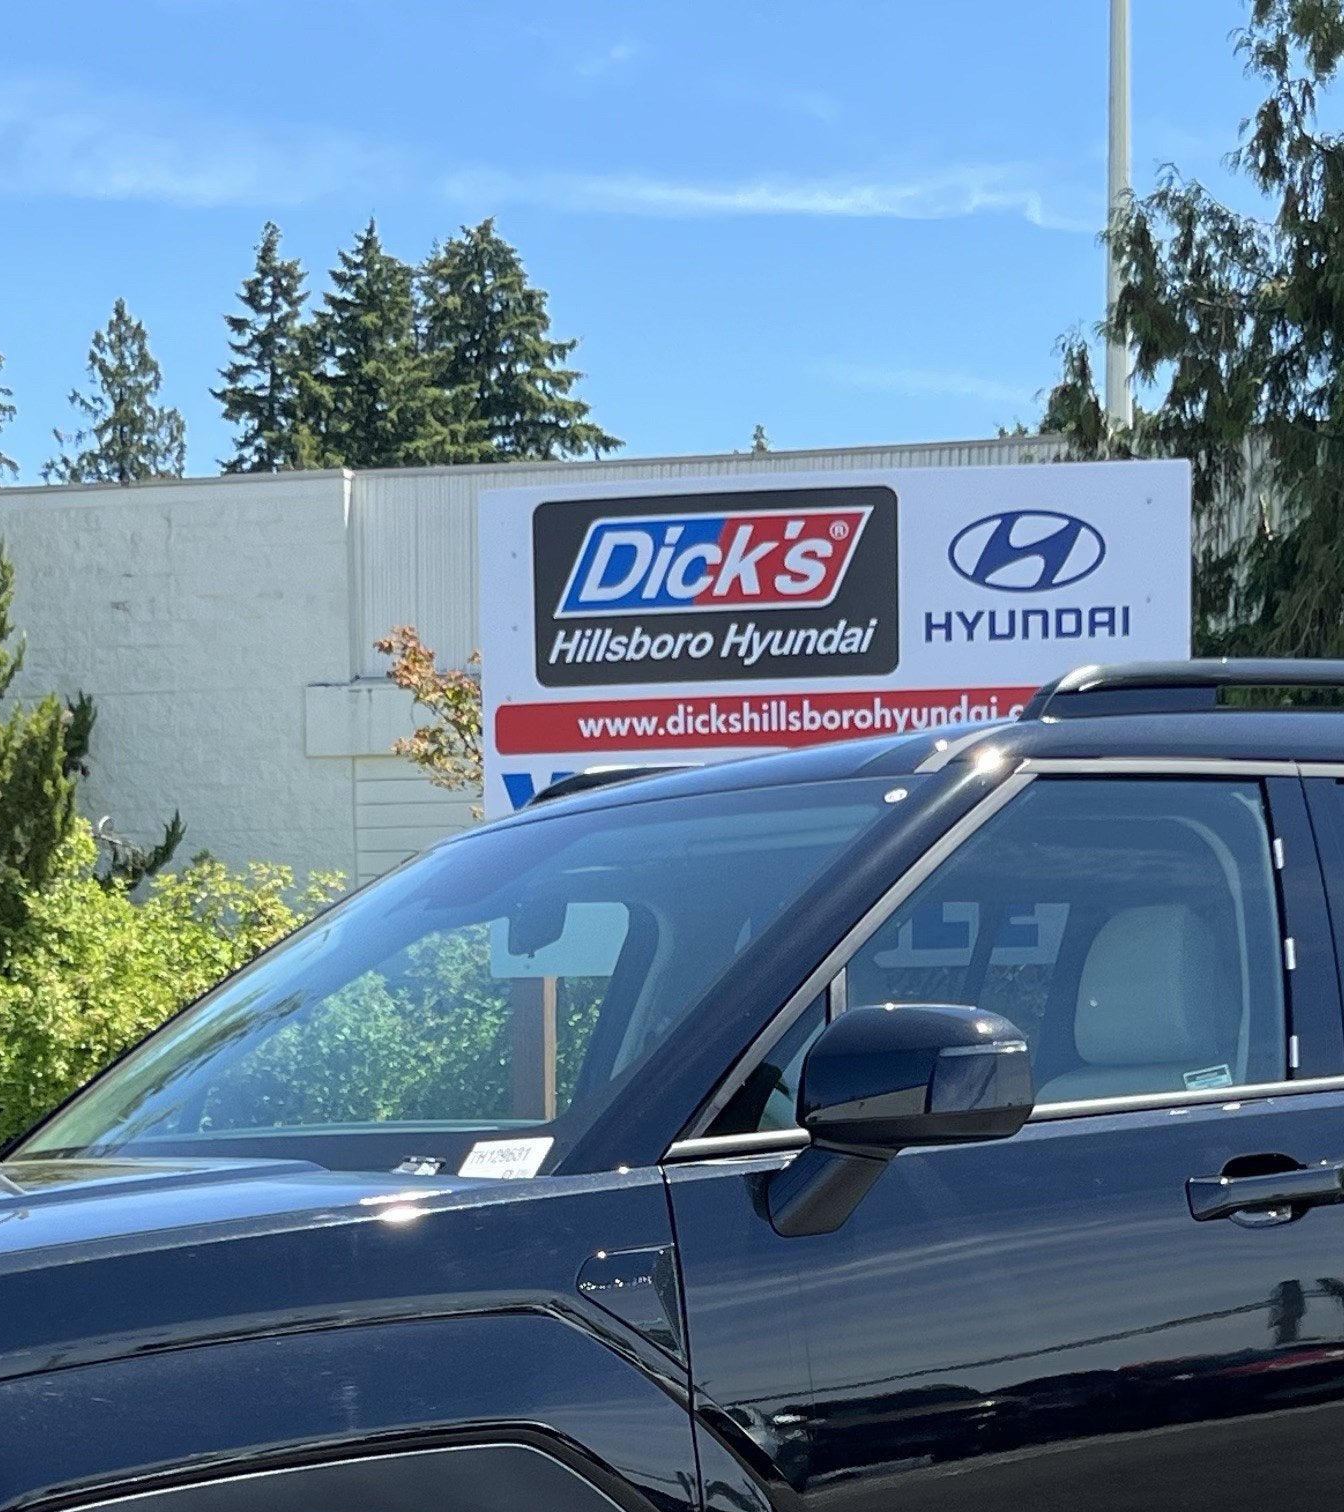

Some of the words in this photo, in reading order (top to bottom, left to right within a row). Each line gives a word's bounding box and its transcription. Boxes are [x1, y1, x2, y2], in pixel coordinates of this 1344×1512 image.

[548, 624, 713, 665] Hillsboro
[721, 618, 878, 667] Hyundai
[924, 605, 1131, 643] HYUNDAI
